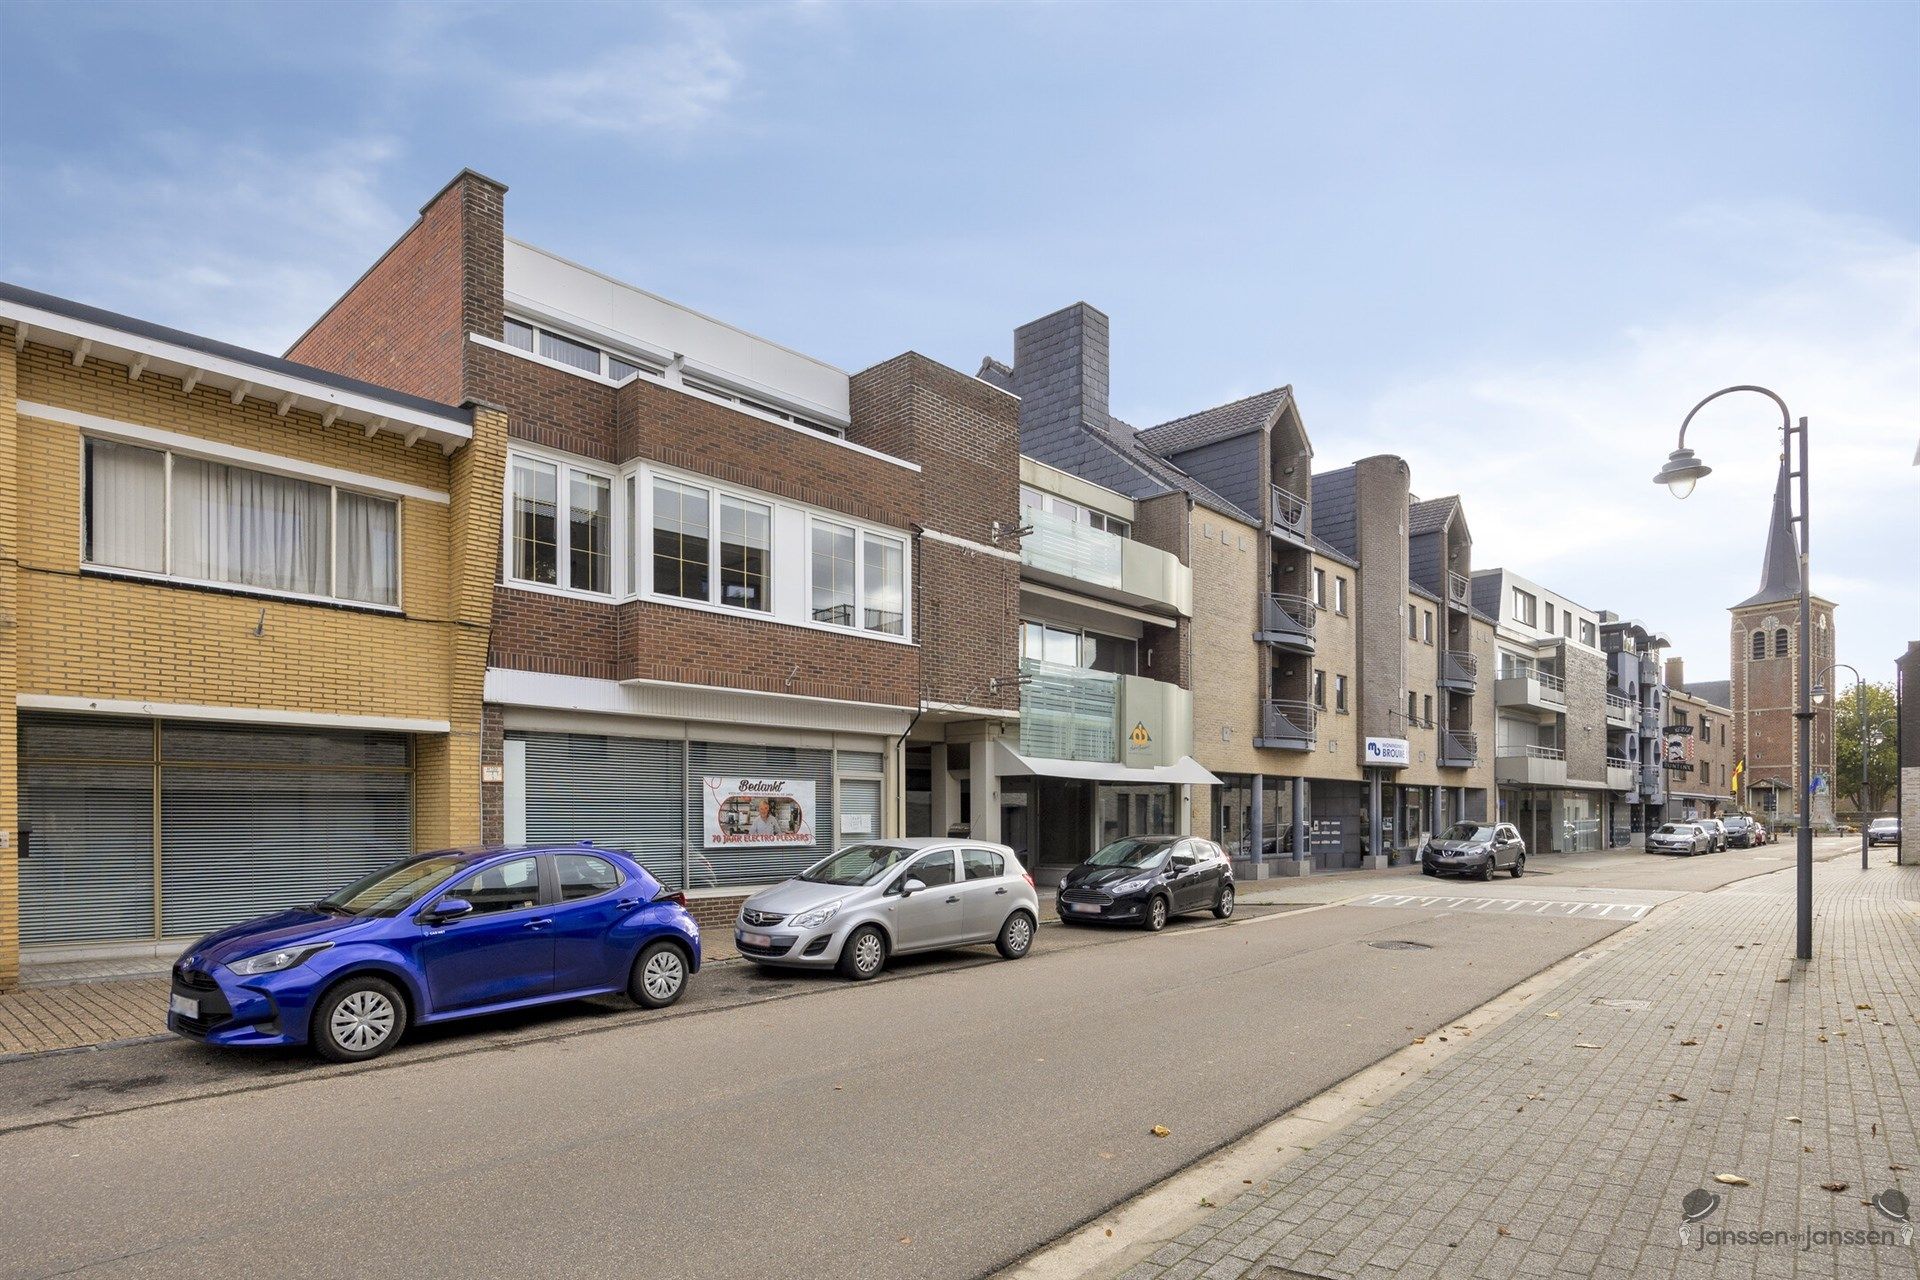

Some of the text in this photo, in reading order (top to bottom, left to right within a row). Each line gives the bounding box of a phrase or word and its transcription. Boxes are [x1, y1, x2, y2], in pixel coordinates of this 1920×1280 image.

[738, 779, 785, 792] Bedankt
[712, 834, 721, 843] 70
[722, 834, 743, 845] JAAR
[743, 833, 775, 843] ELECTRO
